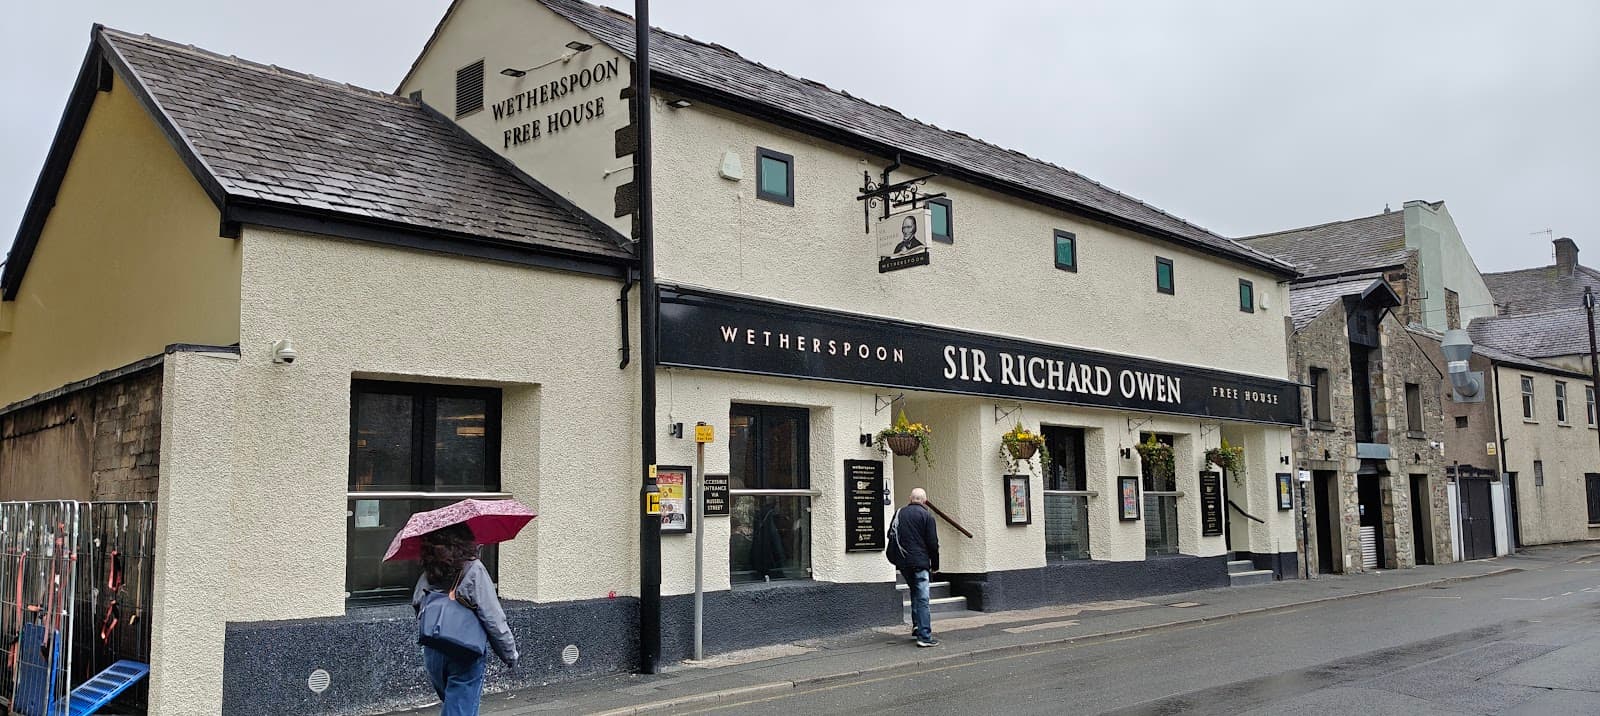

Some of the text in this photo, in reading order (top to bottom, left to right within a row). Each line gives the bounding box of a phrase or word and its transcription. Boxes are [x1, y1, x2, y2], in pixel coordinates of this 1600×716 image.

[492, 57, 619, 121] WETHERSPOON
[504, 97, 604, 148] FREE HOUSE
[720, 325, 904, 364] WETHERSPOON
[944, 345, 1181, 405] SIR RICHARD OWEN
[1212, 386, 1279, 405] FREE HOUSE
